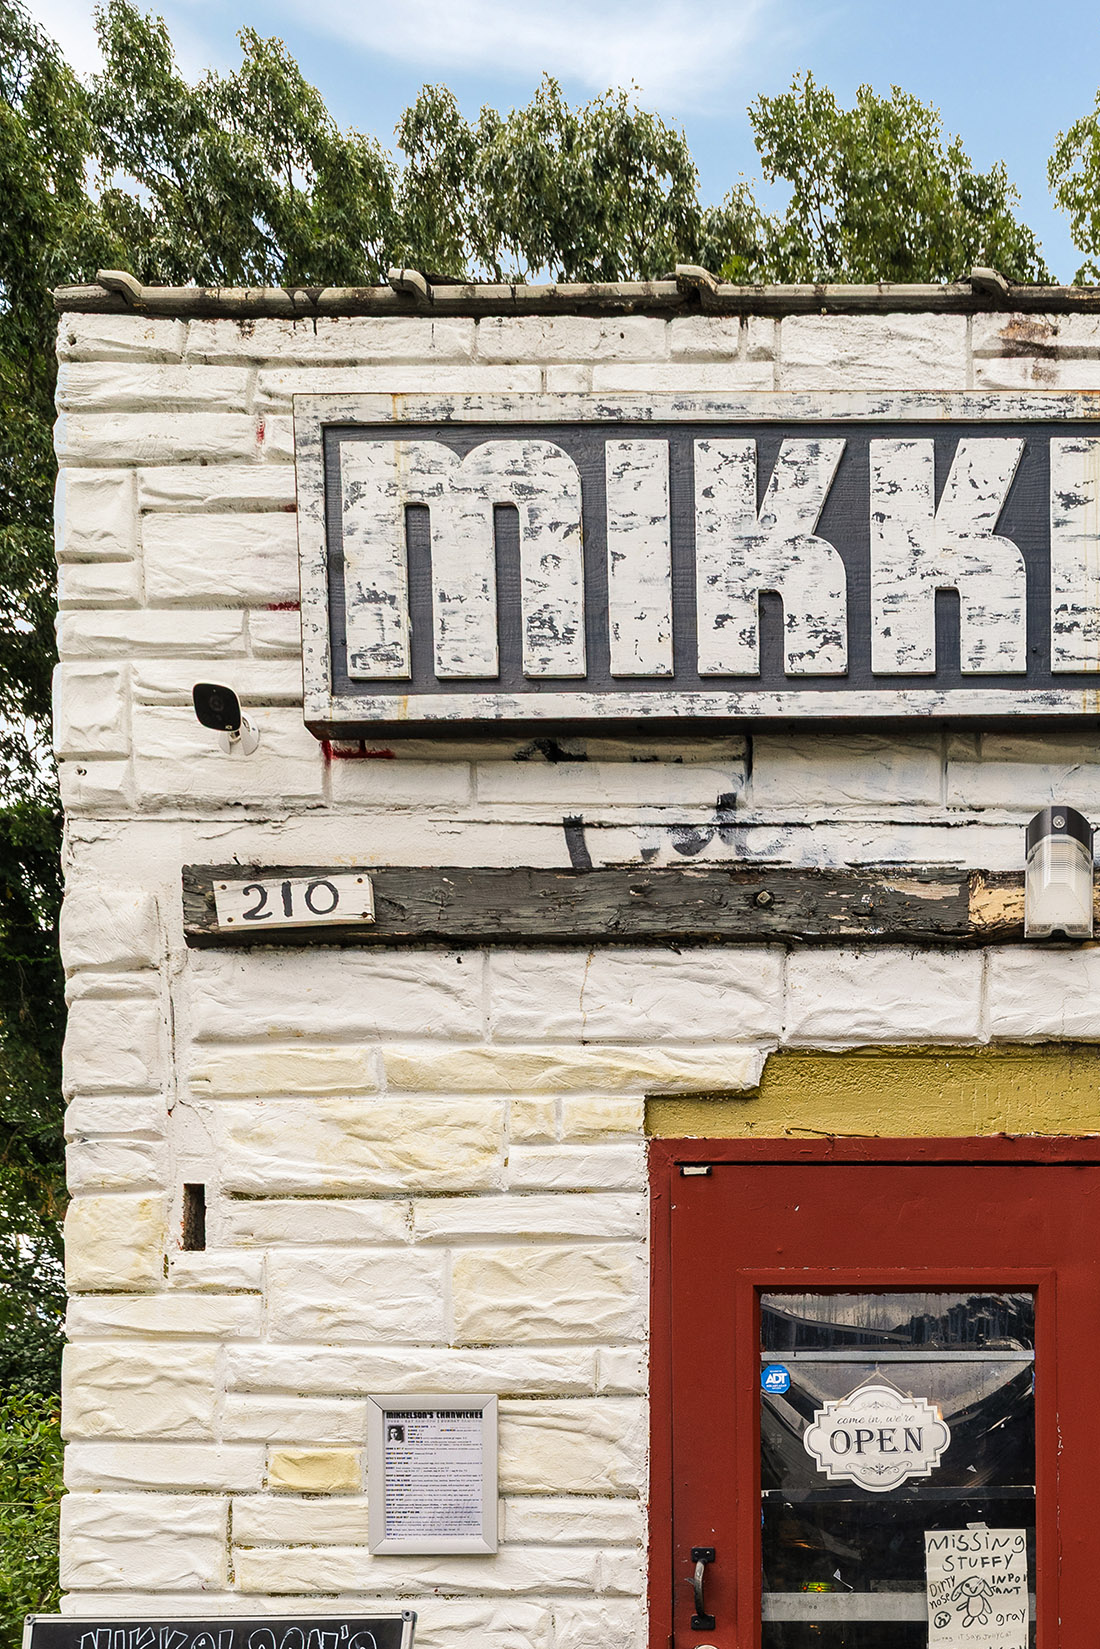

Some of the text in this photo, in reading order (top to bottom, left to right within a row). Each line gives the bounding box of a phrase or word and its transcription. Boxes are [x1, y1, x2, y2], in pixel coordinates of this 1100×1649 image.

[242, 880, 339, 920] 210
[765, 1372, 787, 1384] ADT
[386, 1411, 434, 1419] MIKKELSON'S
[836, 1413, 915, 1425] come in, we're
[829, 1426, 925, 1455] OPEN
[942, 1553, 1013, 1572] STUFFY
